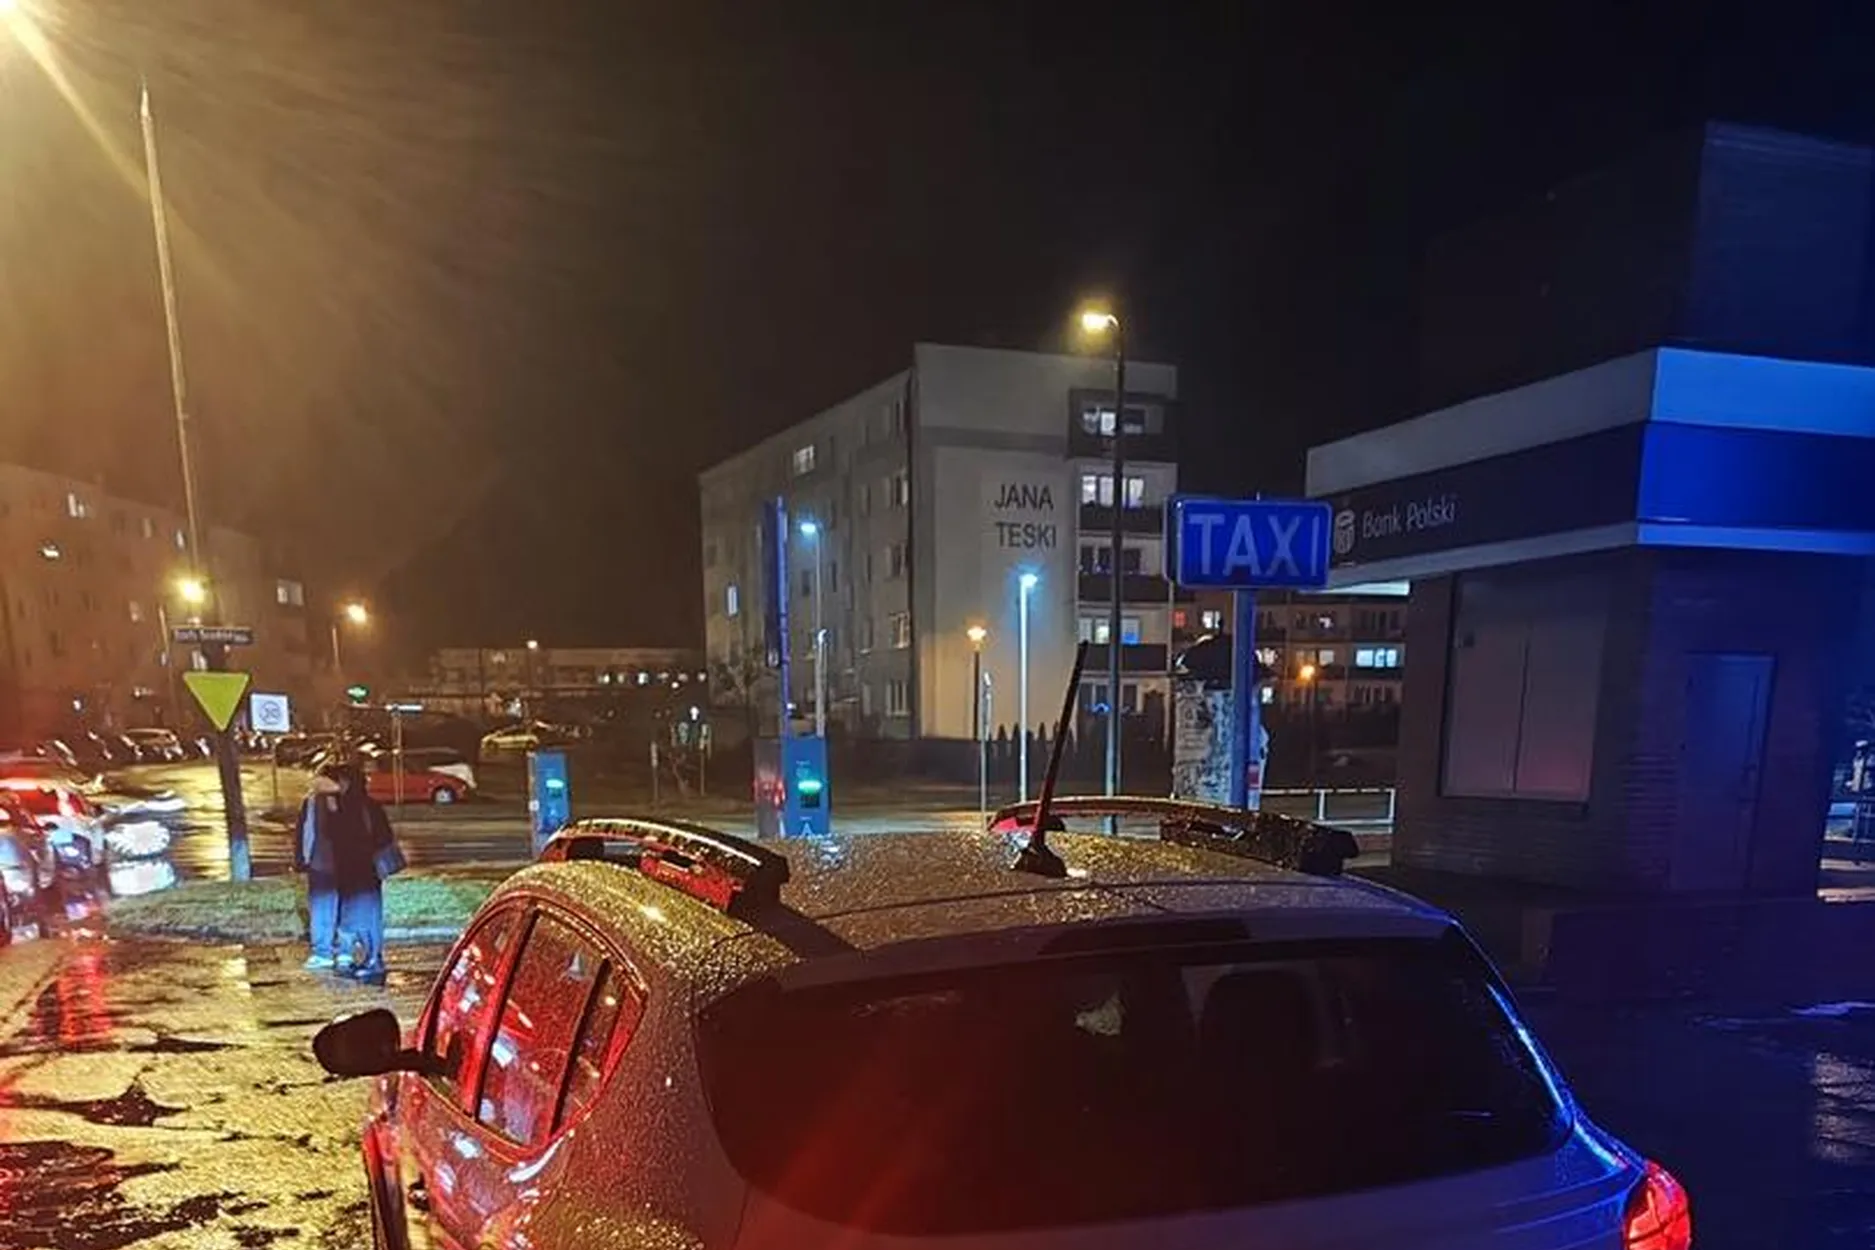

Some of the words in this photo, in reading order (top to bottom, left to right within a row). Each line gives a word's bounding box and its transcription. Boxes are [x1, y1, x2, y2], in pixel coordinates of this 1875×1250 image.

[993, 482, 1054, 511] JANA
[1362, 504, 1402, 538] Bank
[1406, 493, 1455, 531] Polski
[993, 521, 1057, 549] TESKI
[1188, 513, 1320, 577] TAXI
